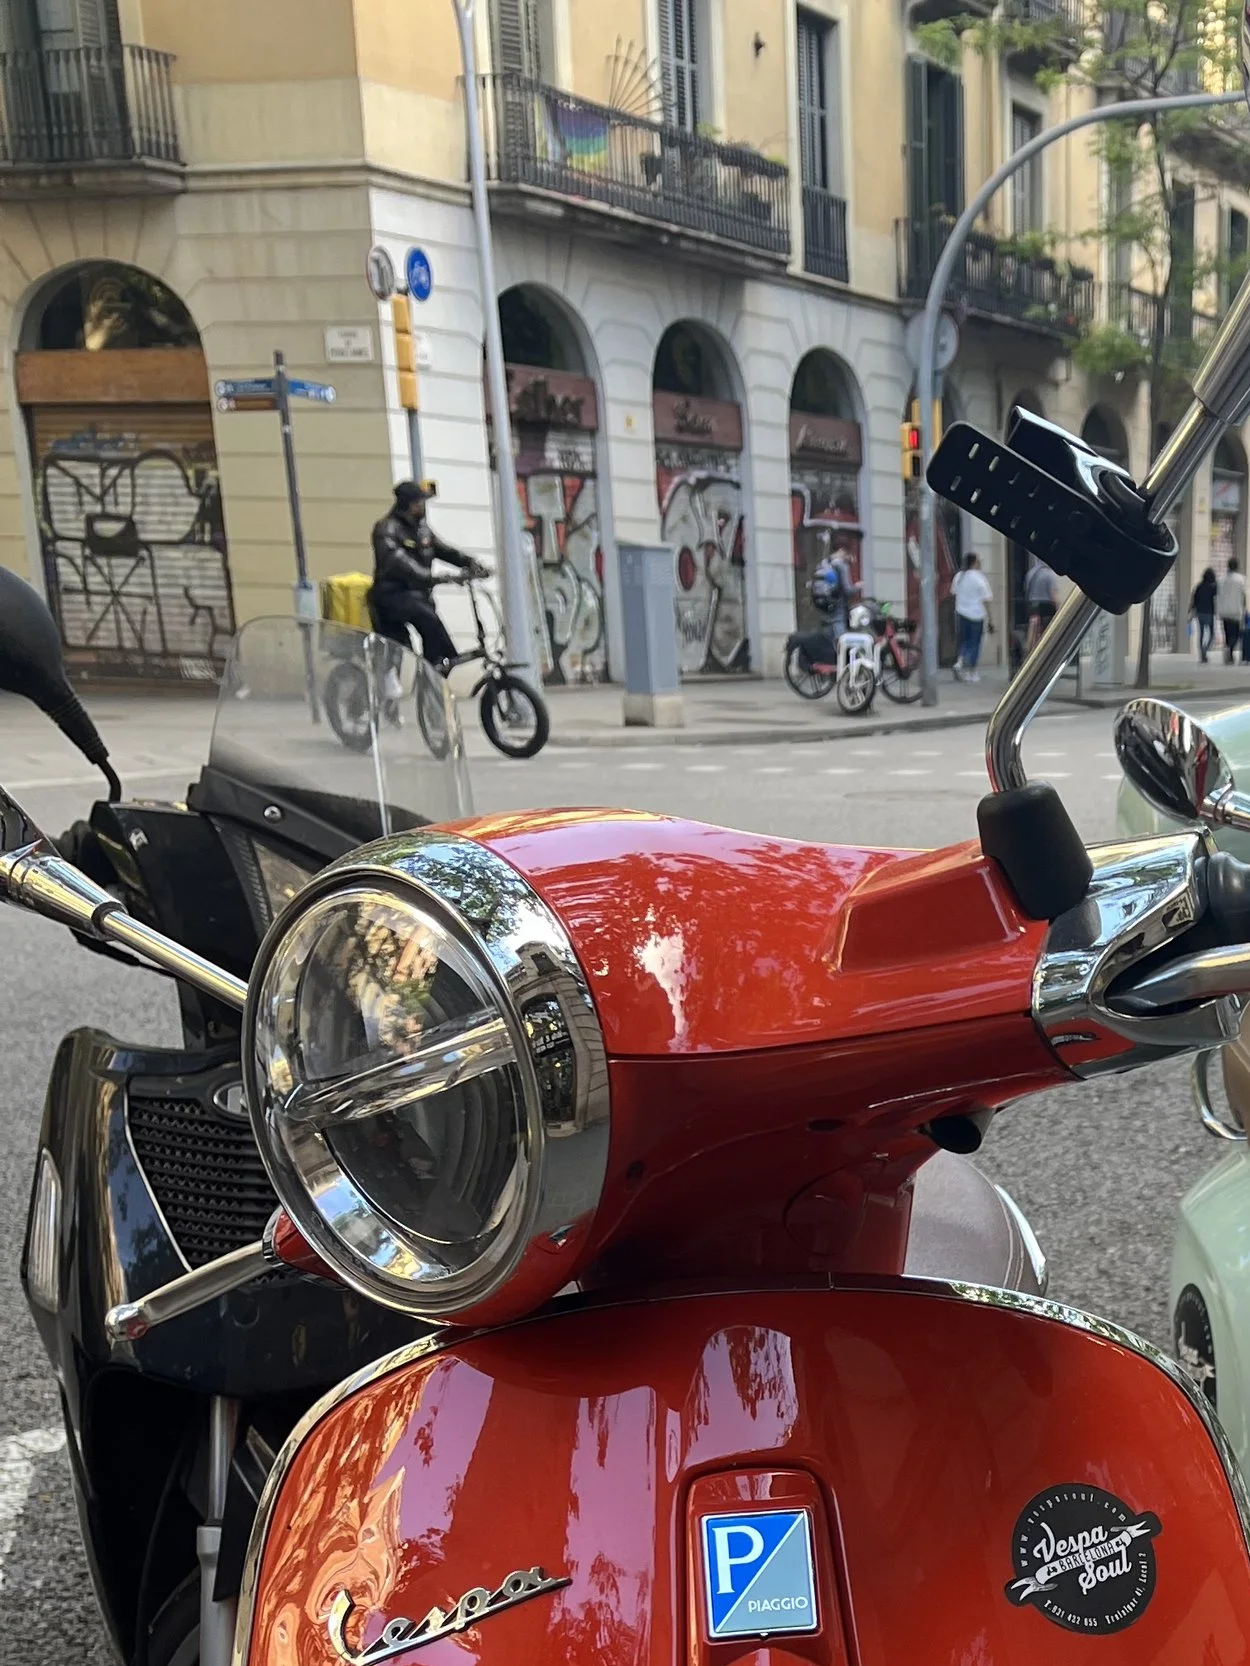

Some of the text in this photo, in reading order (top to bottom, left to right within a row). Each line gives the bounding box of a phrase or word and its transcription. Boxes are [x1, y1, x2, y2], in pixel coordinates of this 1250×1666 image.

[712, 1525, 764, 1594] P
[1033, 1521, 1109, 1563] Vespa
[1058, 1542, 1114, 1571] BARCELONA
[1078, 1546, 1132, 1595] Soul
[748, 1597, 809, 1613] PIAGGIO
